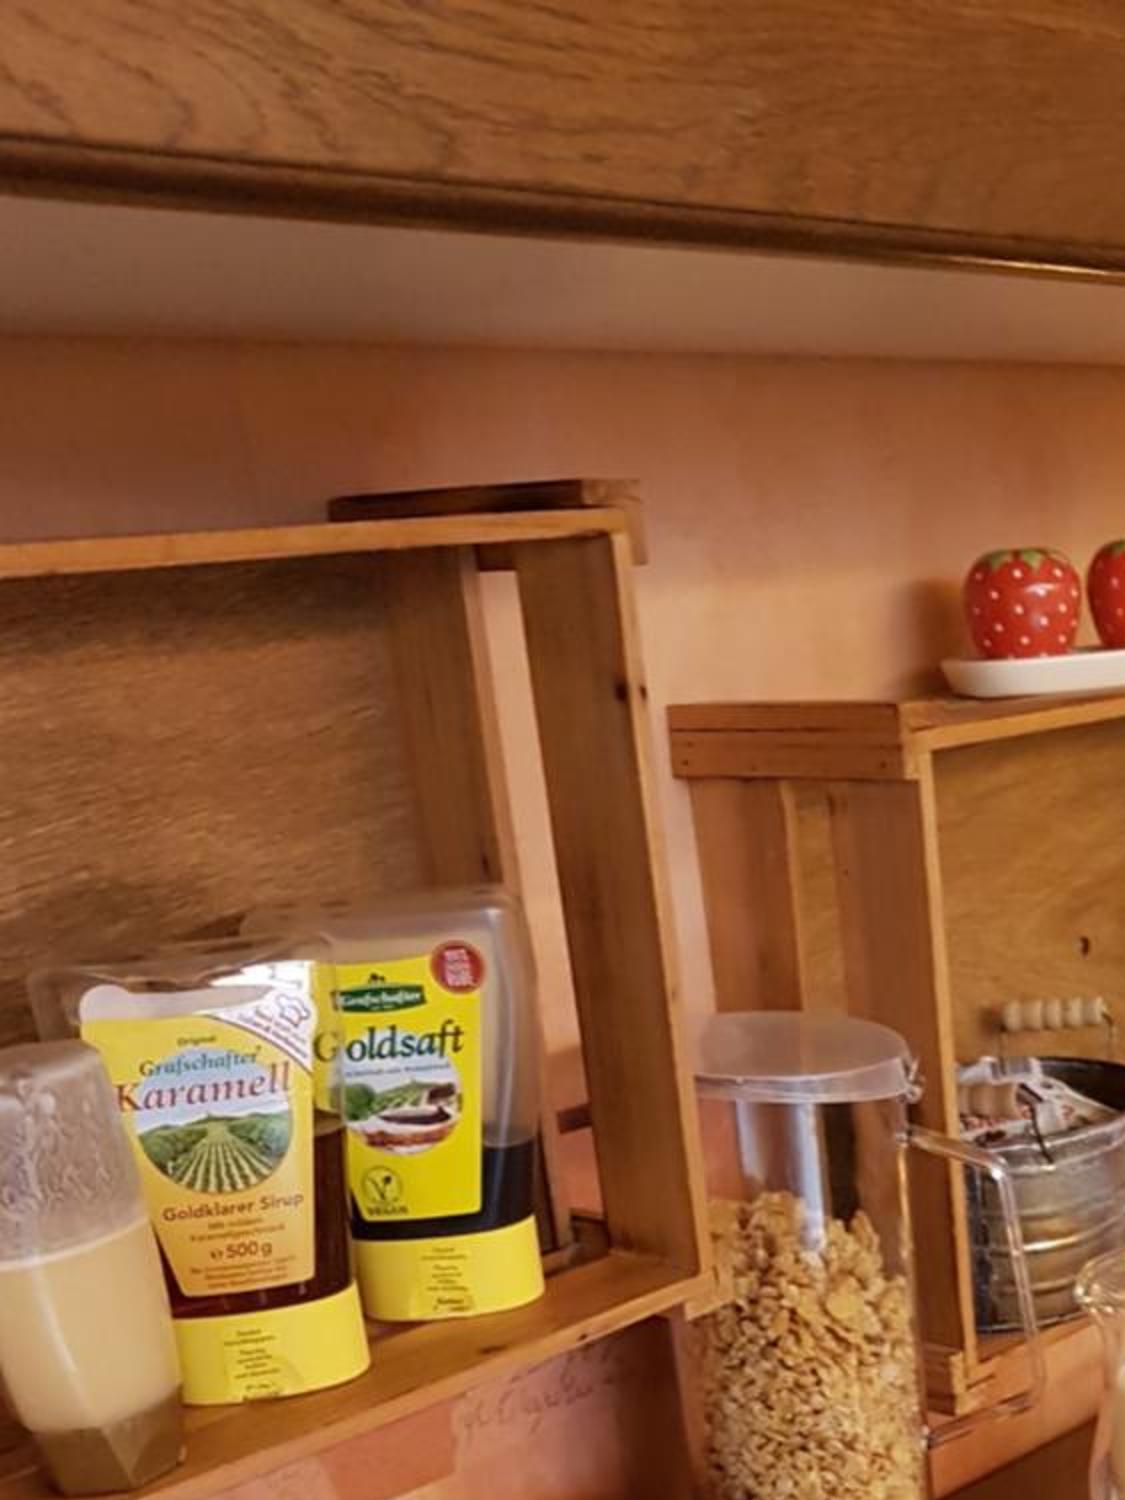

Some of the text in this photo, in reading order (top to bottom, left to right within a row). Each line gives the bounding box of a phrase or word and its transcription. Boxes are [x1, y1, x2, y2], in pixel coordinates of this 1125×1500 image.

[314, 1018, 464, 1062] Goldsaft
[117, 1060, 290, 1112] Karamell
[162, 1193, 305, 1222] Goldklarer Sirup
[226, 1241, 273, 1259] 500 g
